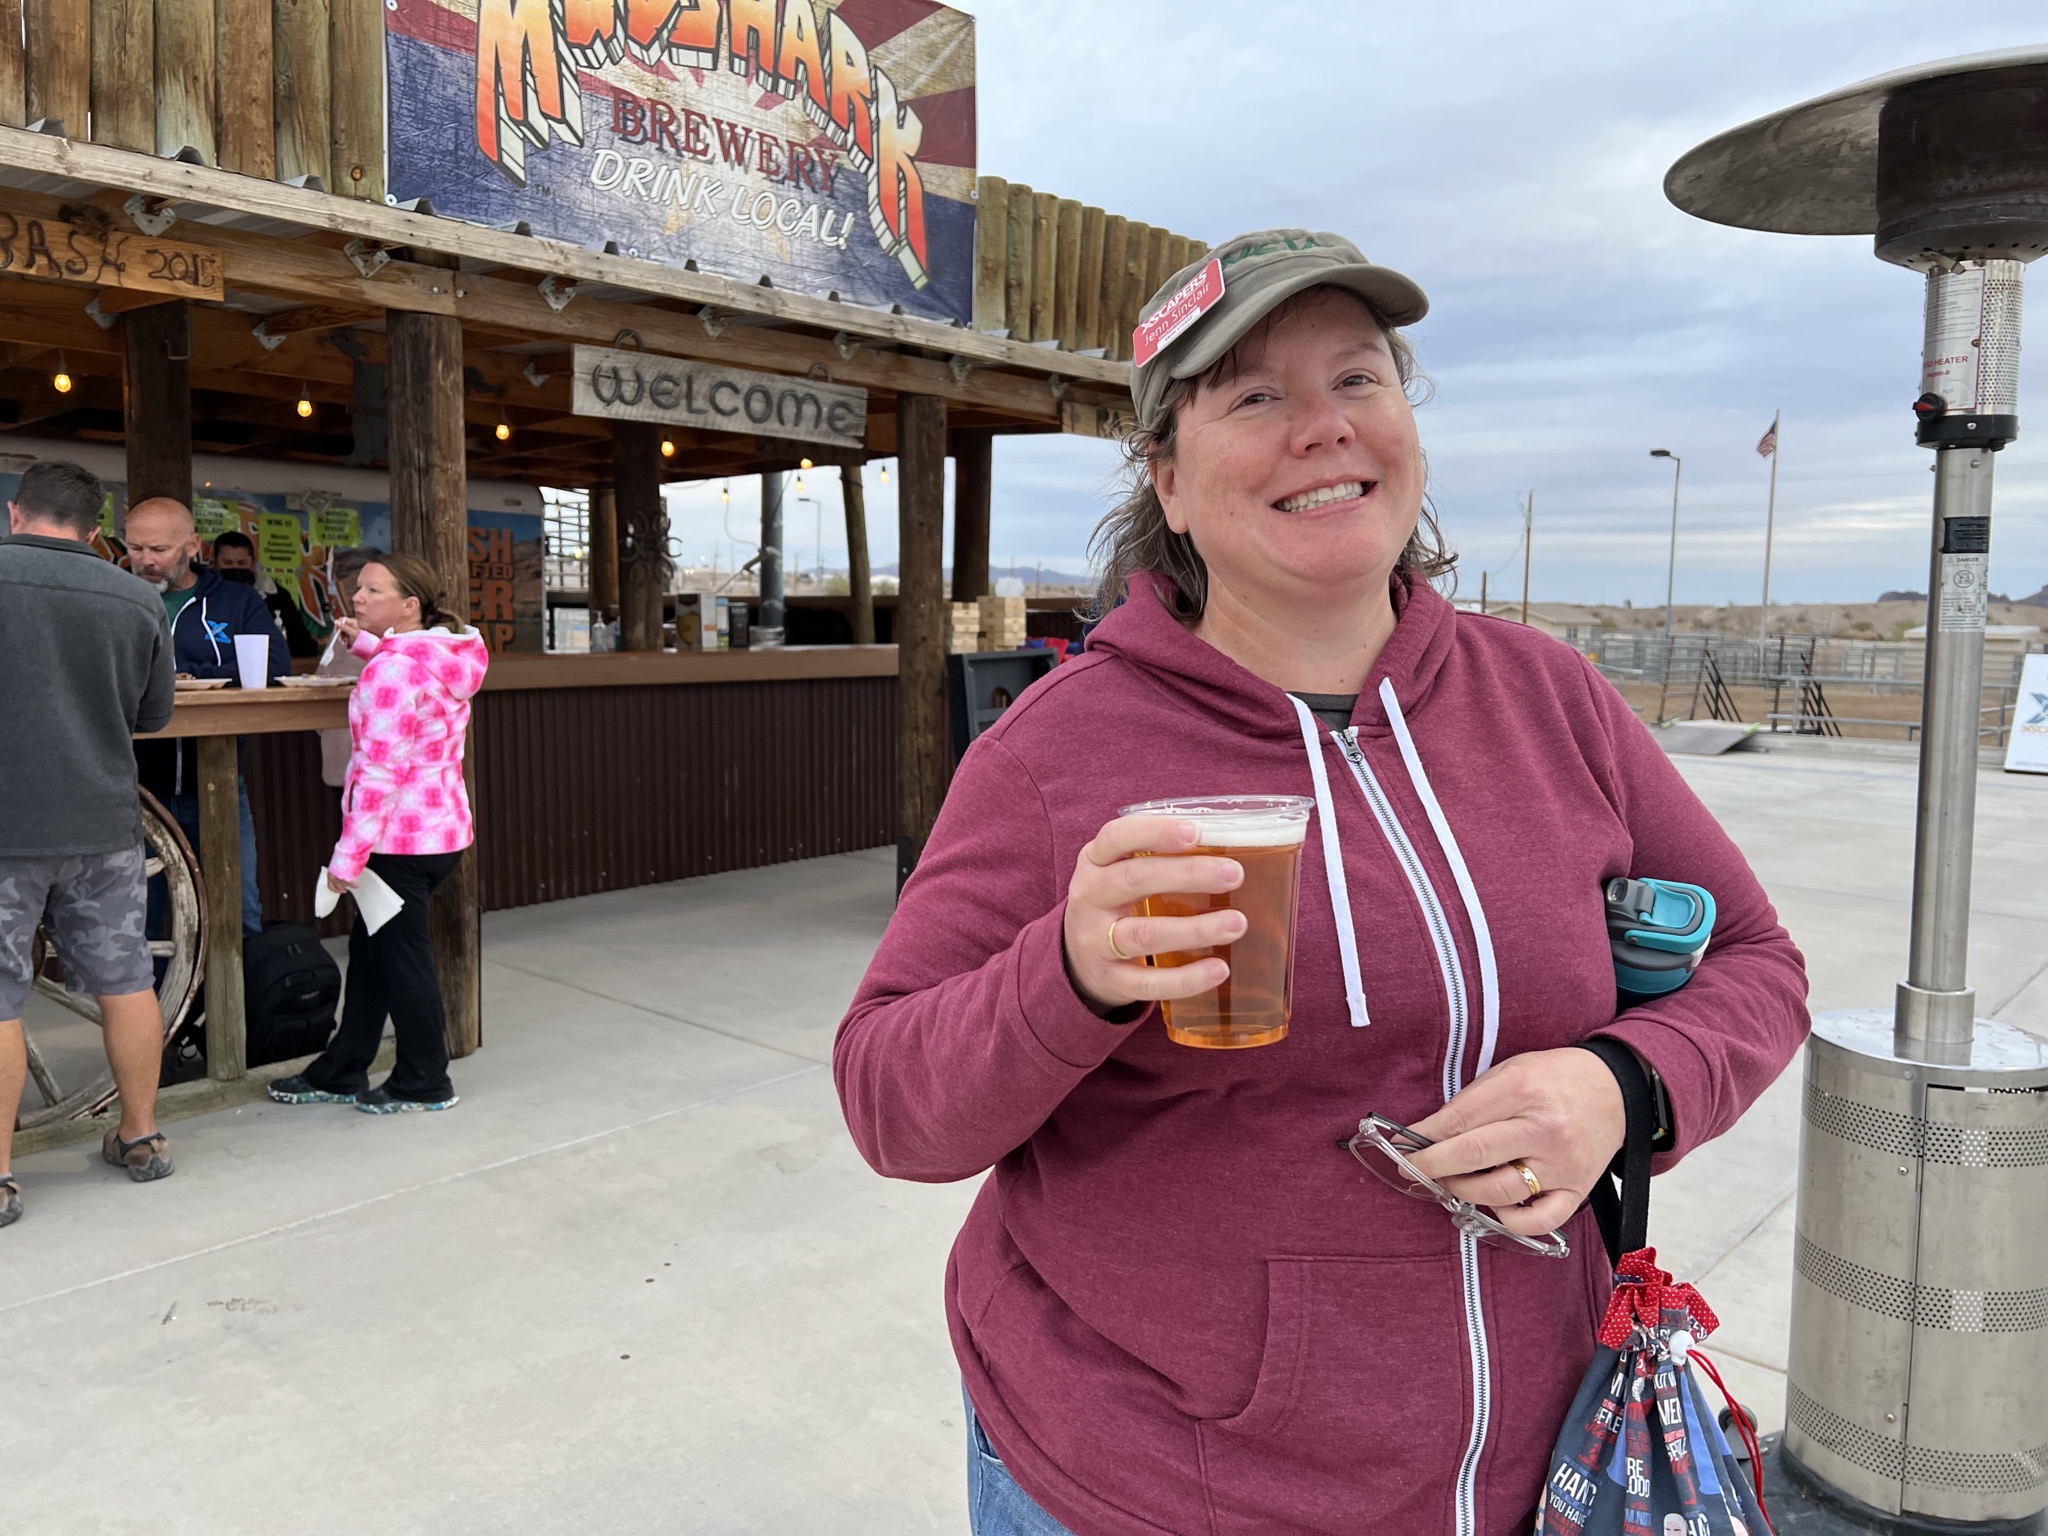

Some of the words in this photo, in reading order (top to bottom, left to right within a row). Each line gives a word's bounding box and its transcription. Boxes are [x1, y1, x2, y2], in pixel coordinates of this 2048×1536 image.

[610, 86, 839, 196] BREWERY
[589, 148, 723, 218] DRINK
[730, 185, 856, 249] LOCAL!
[1140, 266, 1209, 336] XSCAPERS
[1145, 320, 1169, 347] Jenn
[1171, 282, 1210, 322] Sinclair
[1934, 355, 1969, 366] HEATER
[592, 363, 857, 435] WELCOME
[468, 527, 512, 562] SH
[472, 563, 513, 578] FTED
[468, 580, 514, 620] ER
